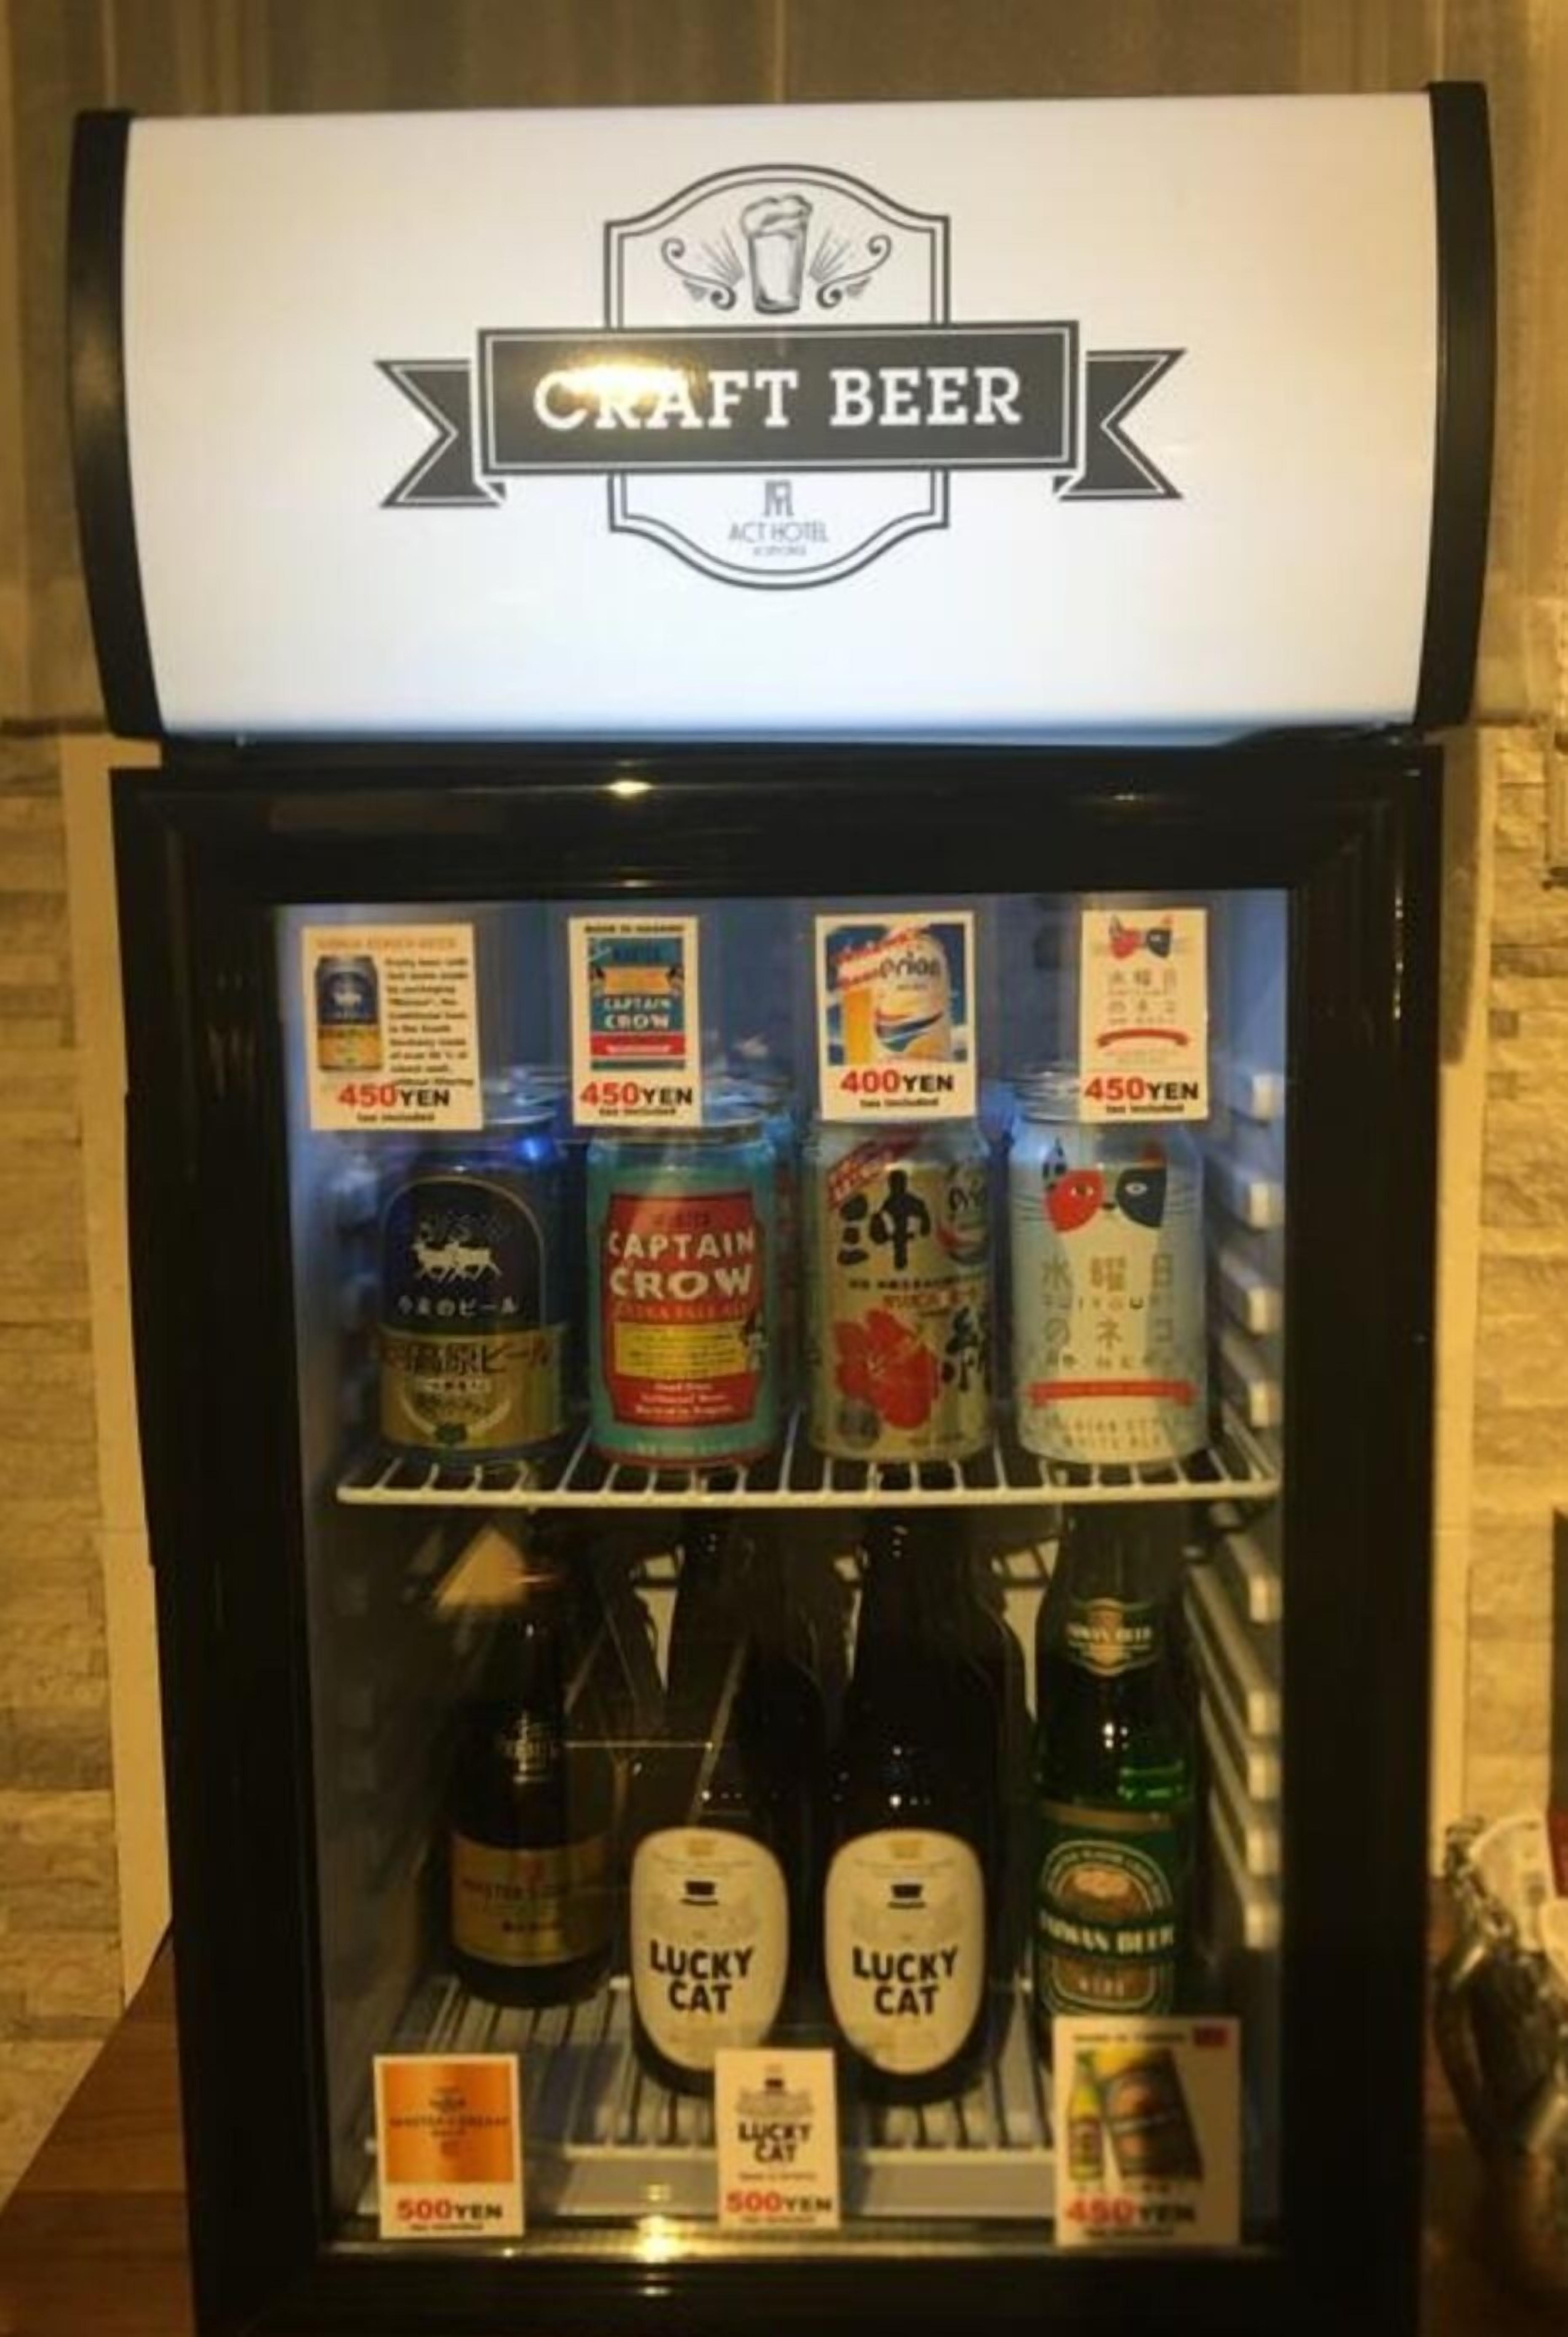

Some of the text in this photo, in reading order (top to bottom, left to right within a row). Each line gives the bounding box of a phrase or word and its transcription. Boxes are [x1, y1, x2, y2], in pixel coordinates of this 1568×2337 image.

[534, 366, 1022, 430] CRAFT BEER
[729, 521, 829, 543] ACT HOTEL
[603, 997, 671, 1010] CAPTAIN
[604, 1014, 669, 1029] CROW
[840, 1069, 954, 1093] 400YEN
[1085, 1076, 1198, 1101] 450YEN
[338, 1082, 449, 1107] 450YEN
[580, 1082, 692, 1107] 450YEN
[608, 1228, 754, 1261] CAPTAIN
[609, 1265, 752, 1300] CROW
[650, 1939, 754, 1980] LUCKY
[852, 1944, 958, 1982] LUCKY
[668, 1979, 732, 2014] CAT
[874, 1985, 939, 2016] CAT
[738, 2121, 810, 2143] LUCKY
[754, 2141, 796, 2163] CAT
